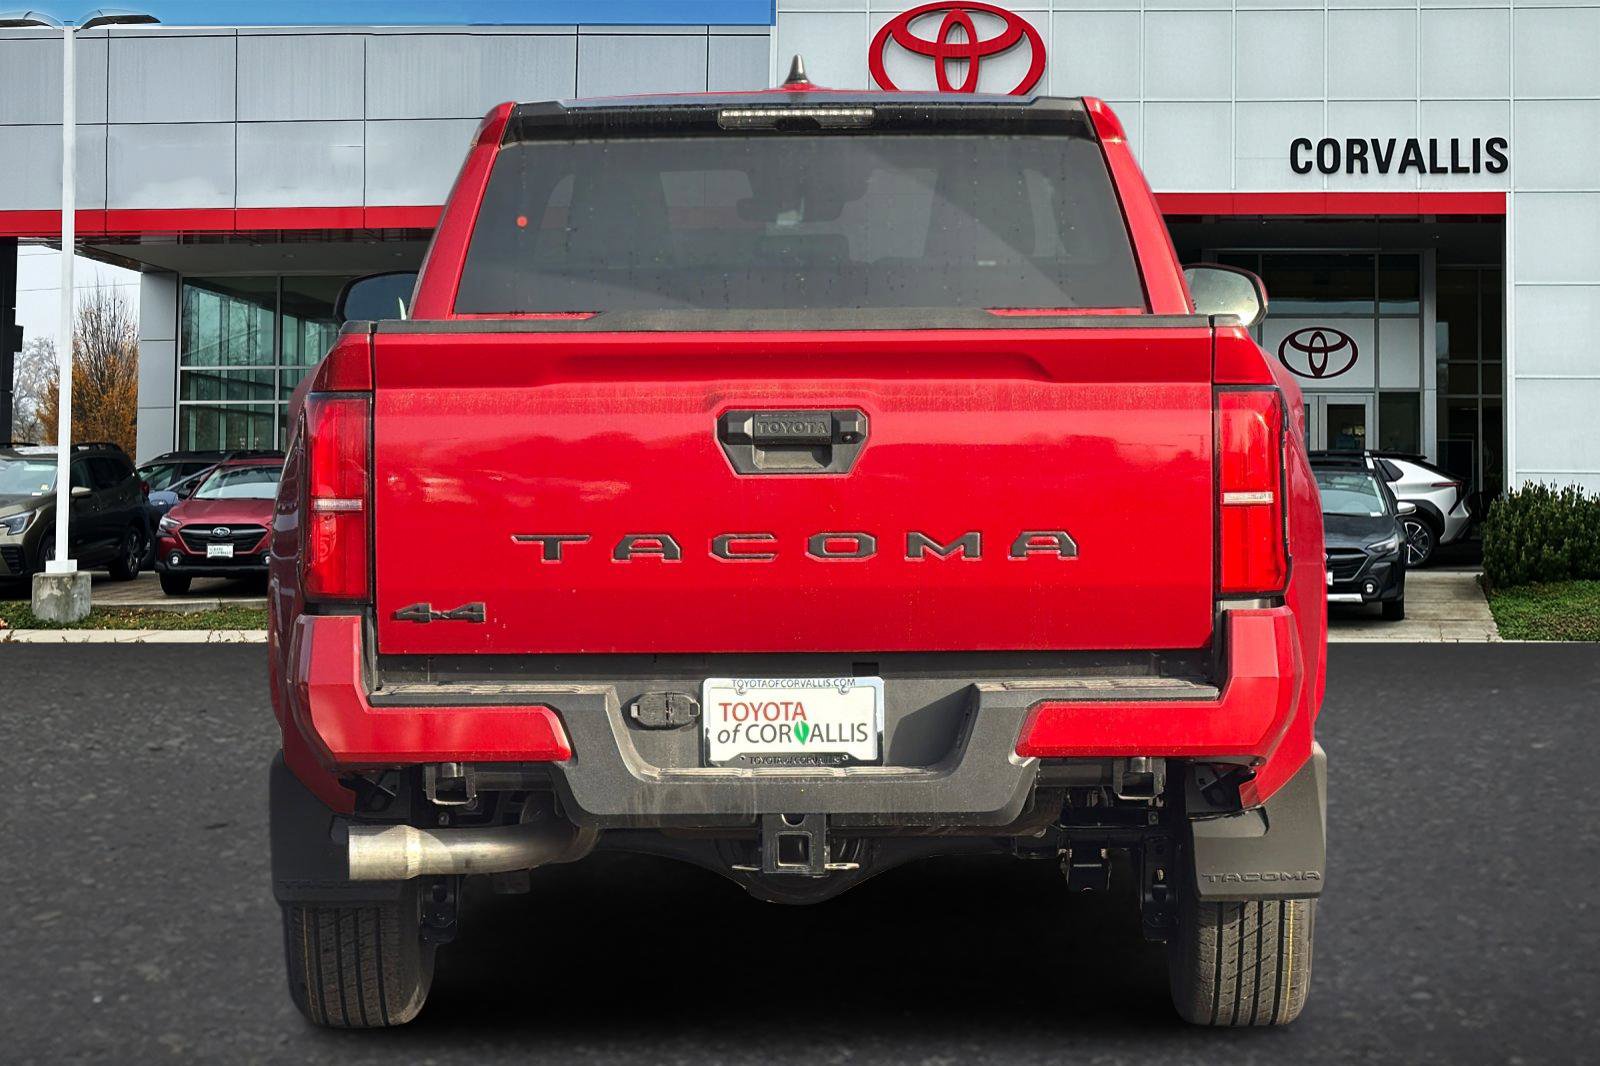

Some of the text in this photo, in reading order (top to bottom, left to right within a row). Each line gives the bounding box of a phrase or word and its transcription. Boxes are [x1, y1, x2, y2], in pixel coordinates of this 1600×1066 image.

[1290, 137, 1509, 174] CORVALLIS
[757, 421, 828, 434] TOYOTA
[511, 531, 1079, 563] TACOMA
[732, 678, 856, 688] TOYOTAOFCORVALLIS.COM
[718, 701, 807, 722] TOYOTA
[717, 723, 742, 744] of
[749, 756, 782, 765] TOYOTA
[1201, 871, 1321, 882] TACOMA
